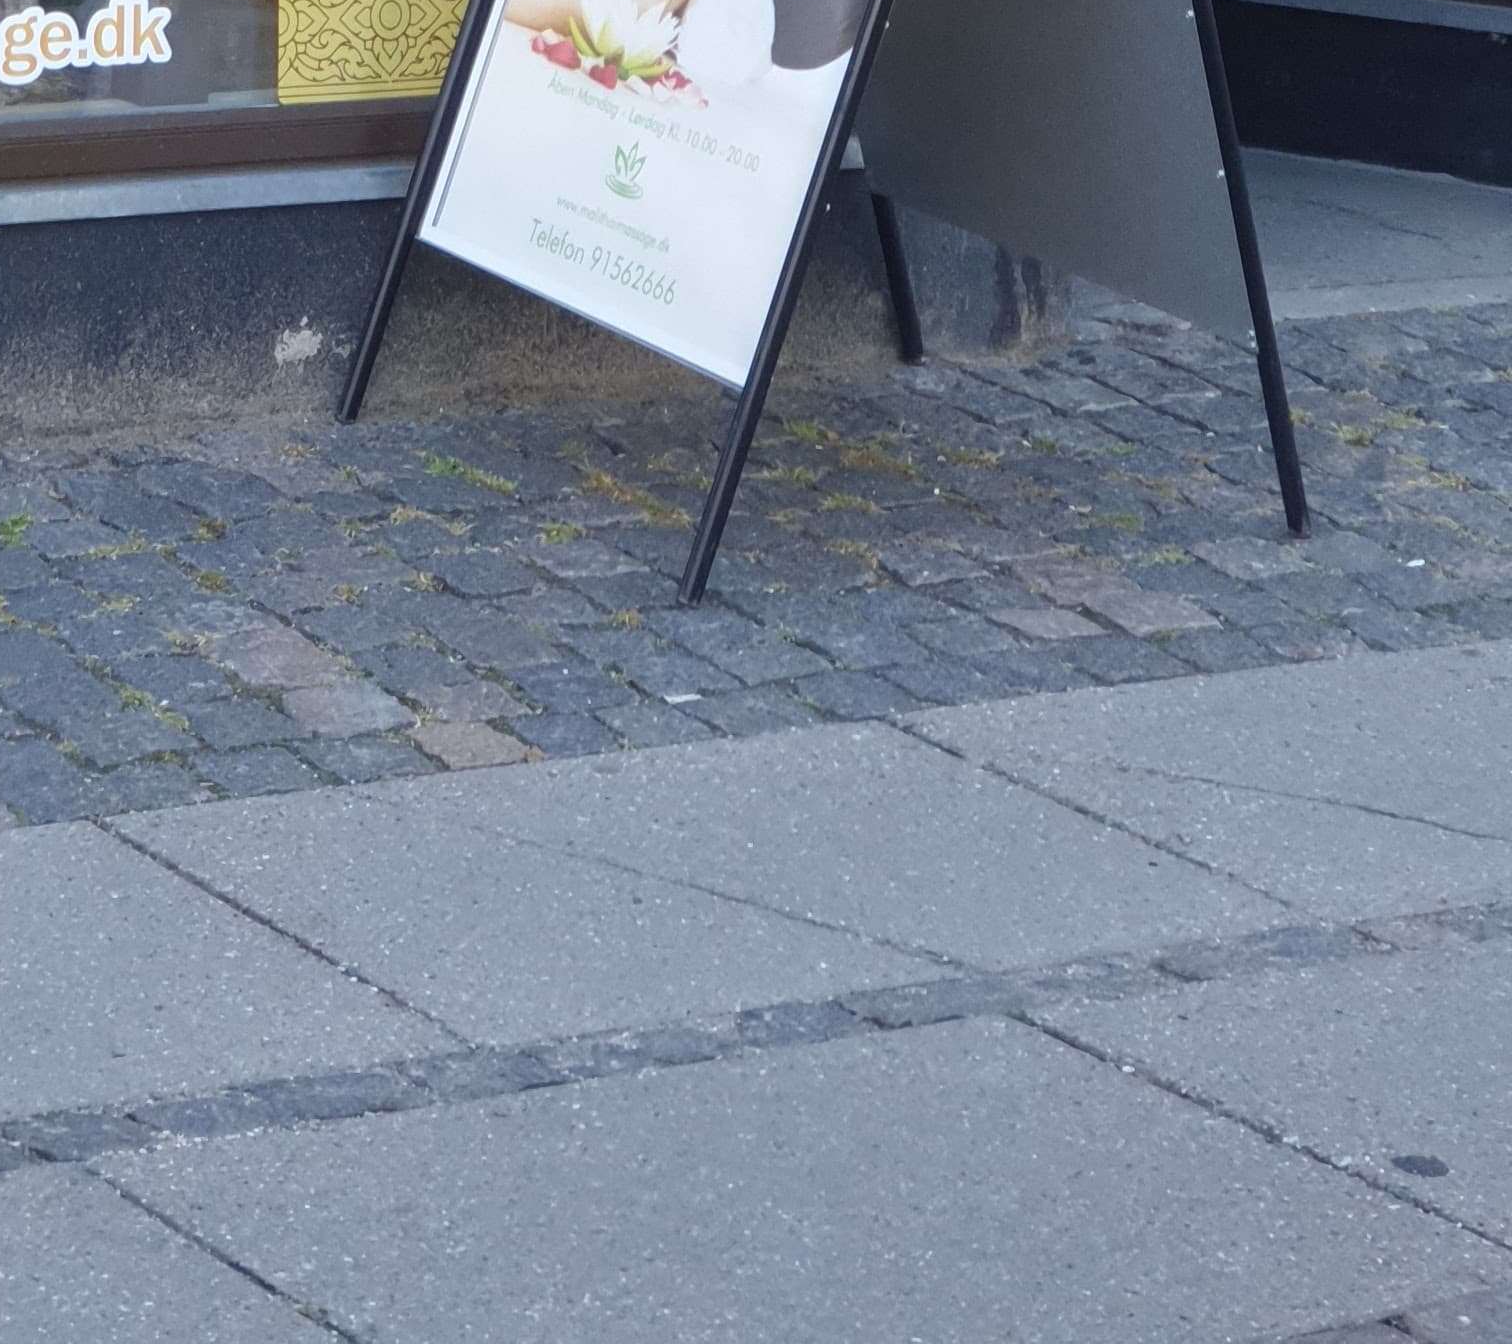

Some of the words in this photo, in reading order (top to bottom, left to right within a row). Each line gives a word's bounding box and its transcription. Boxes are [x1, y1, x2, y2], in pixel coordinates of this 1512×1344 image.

[577, 88, 619, 119] Mandag
[529, 218, 585, 265] Telefon
[589, 245, 677, 305] 91562666
